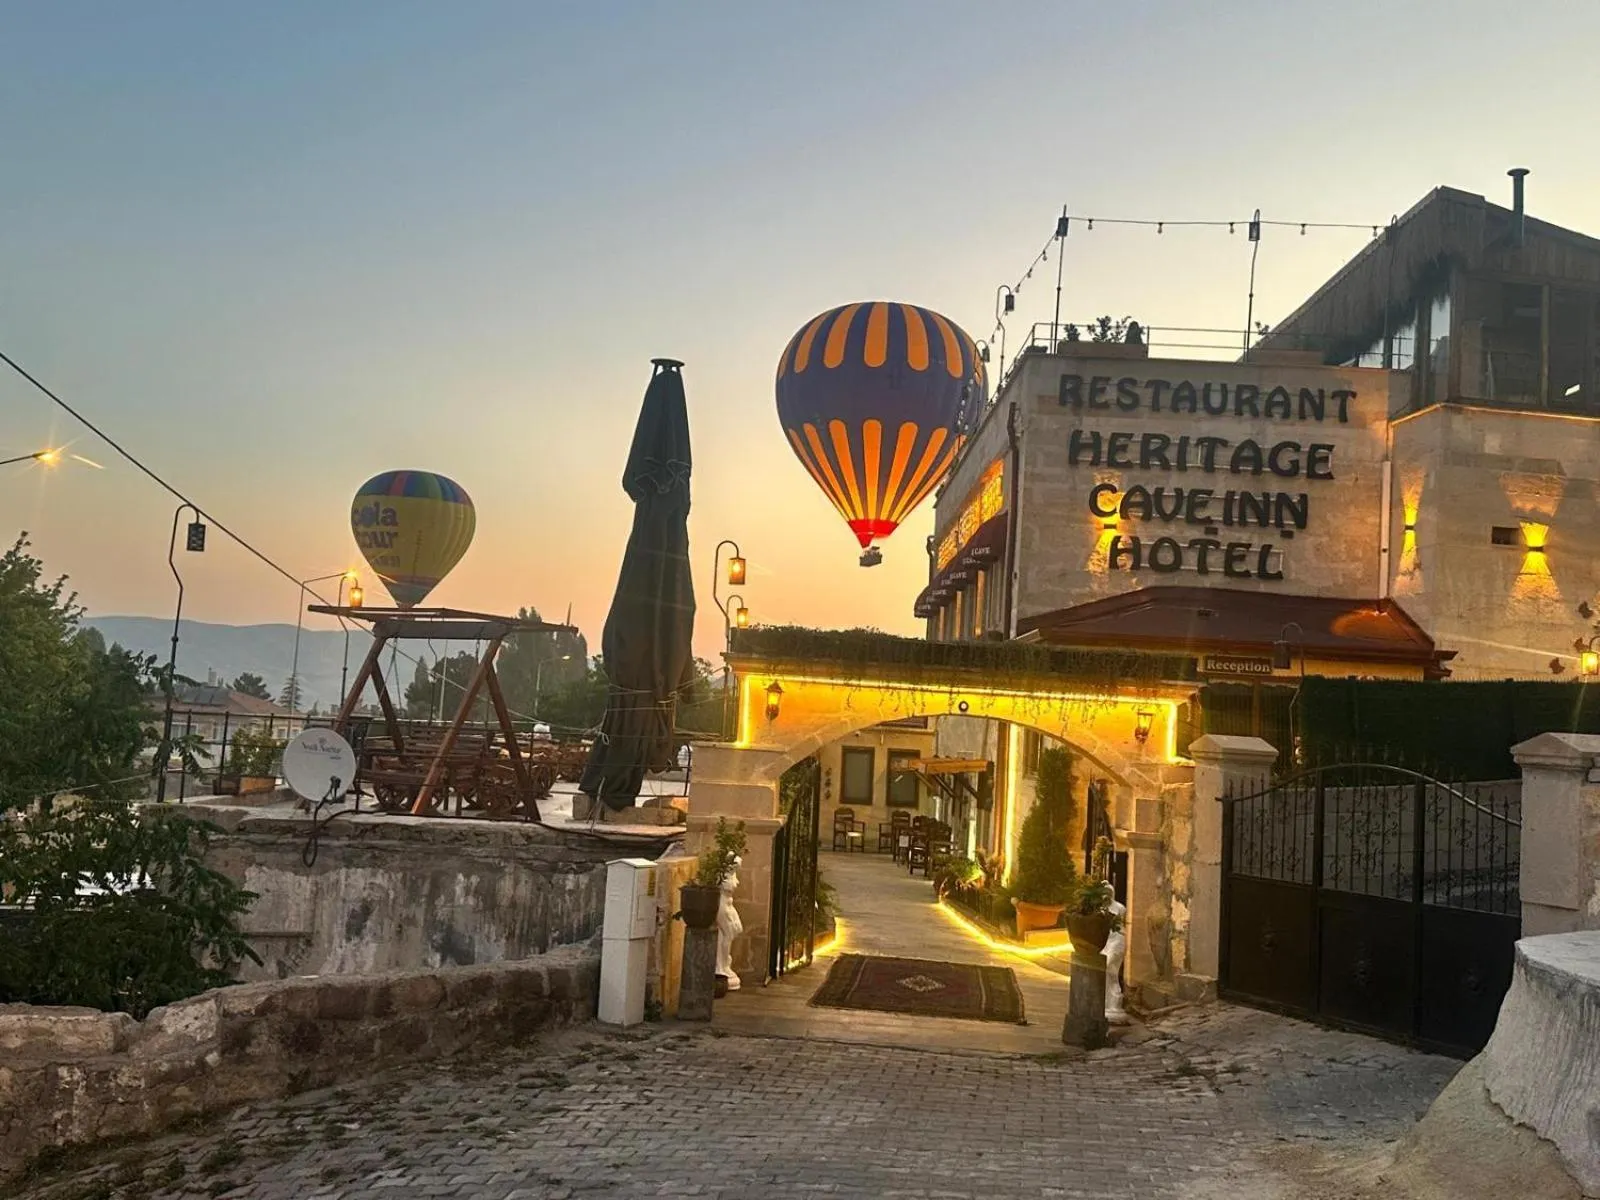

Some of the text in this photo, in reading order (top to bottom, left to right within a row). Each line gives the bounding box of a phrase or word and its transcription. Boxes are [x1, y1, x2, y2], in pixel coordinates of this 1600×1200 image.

[1058, 374, 1357, 423] RESTAURANT
[1068, 429, 1335, 480] HERITAGE
[1088, 483, 1309, 530] CAVE INN
[1108, 535, 1284, 580] HOTEL
[1206, 659, 1271, 673] Reception
